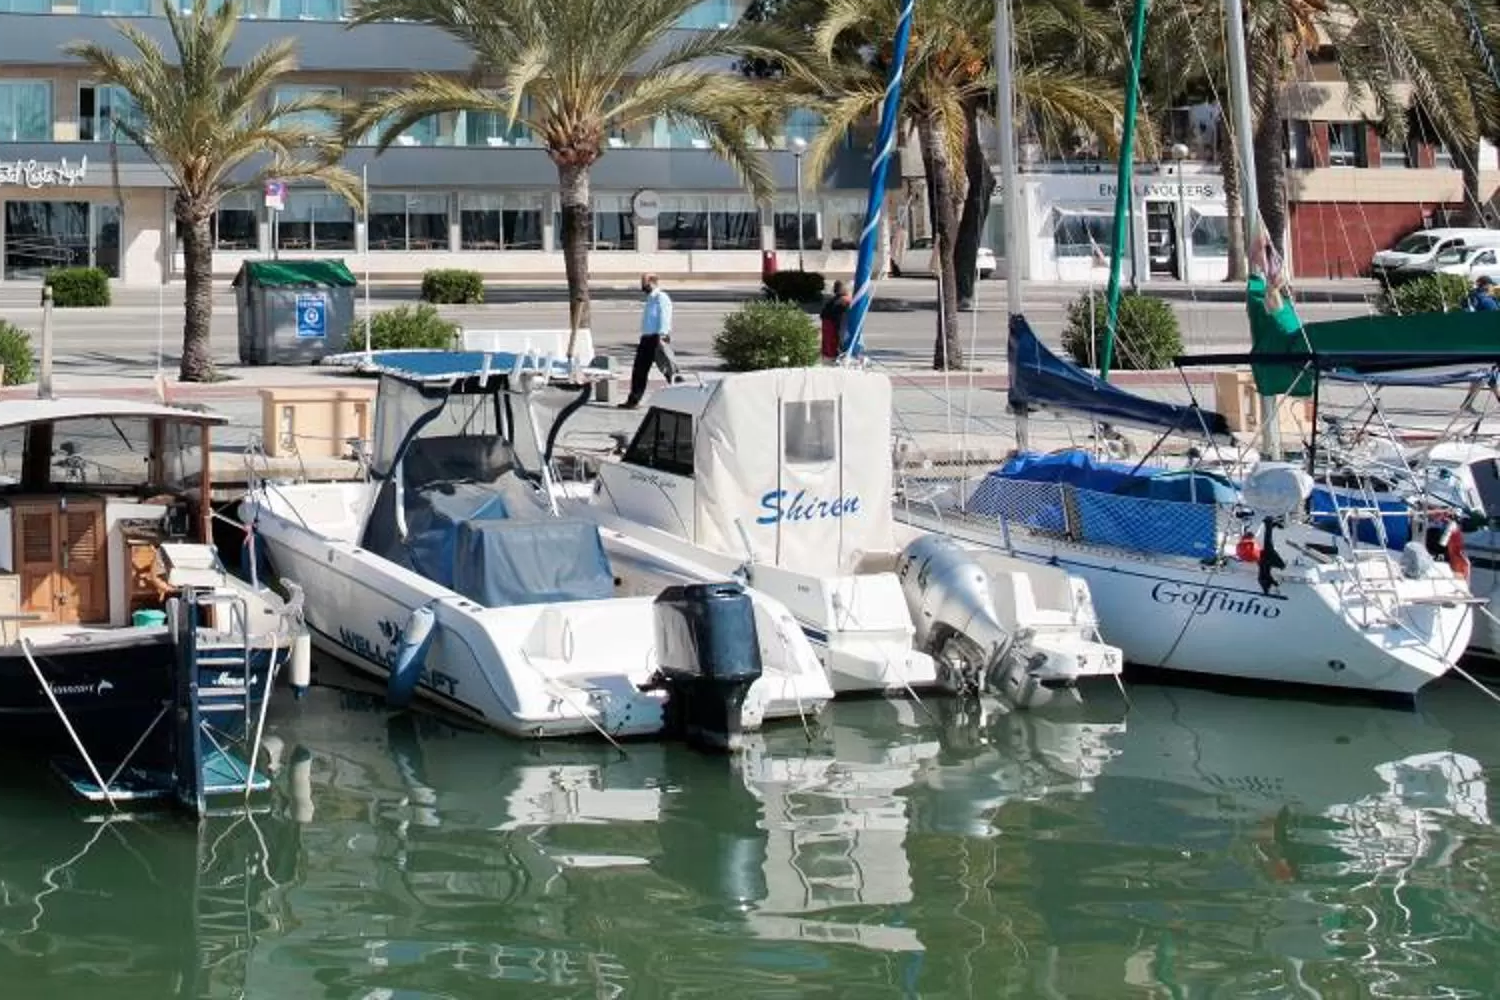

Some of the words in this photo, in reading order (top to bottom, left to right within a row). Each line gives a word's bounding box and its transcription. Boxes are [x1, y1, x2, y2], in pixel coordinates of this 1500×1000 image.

[21, 159, 56, 189] Costa
[756, 488, 860, 526] Shiren
[1151, 580, 1282, 620] Golfinho
